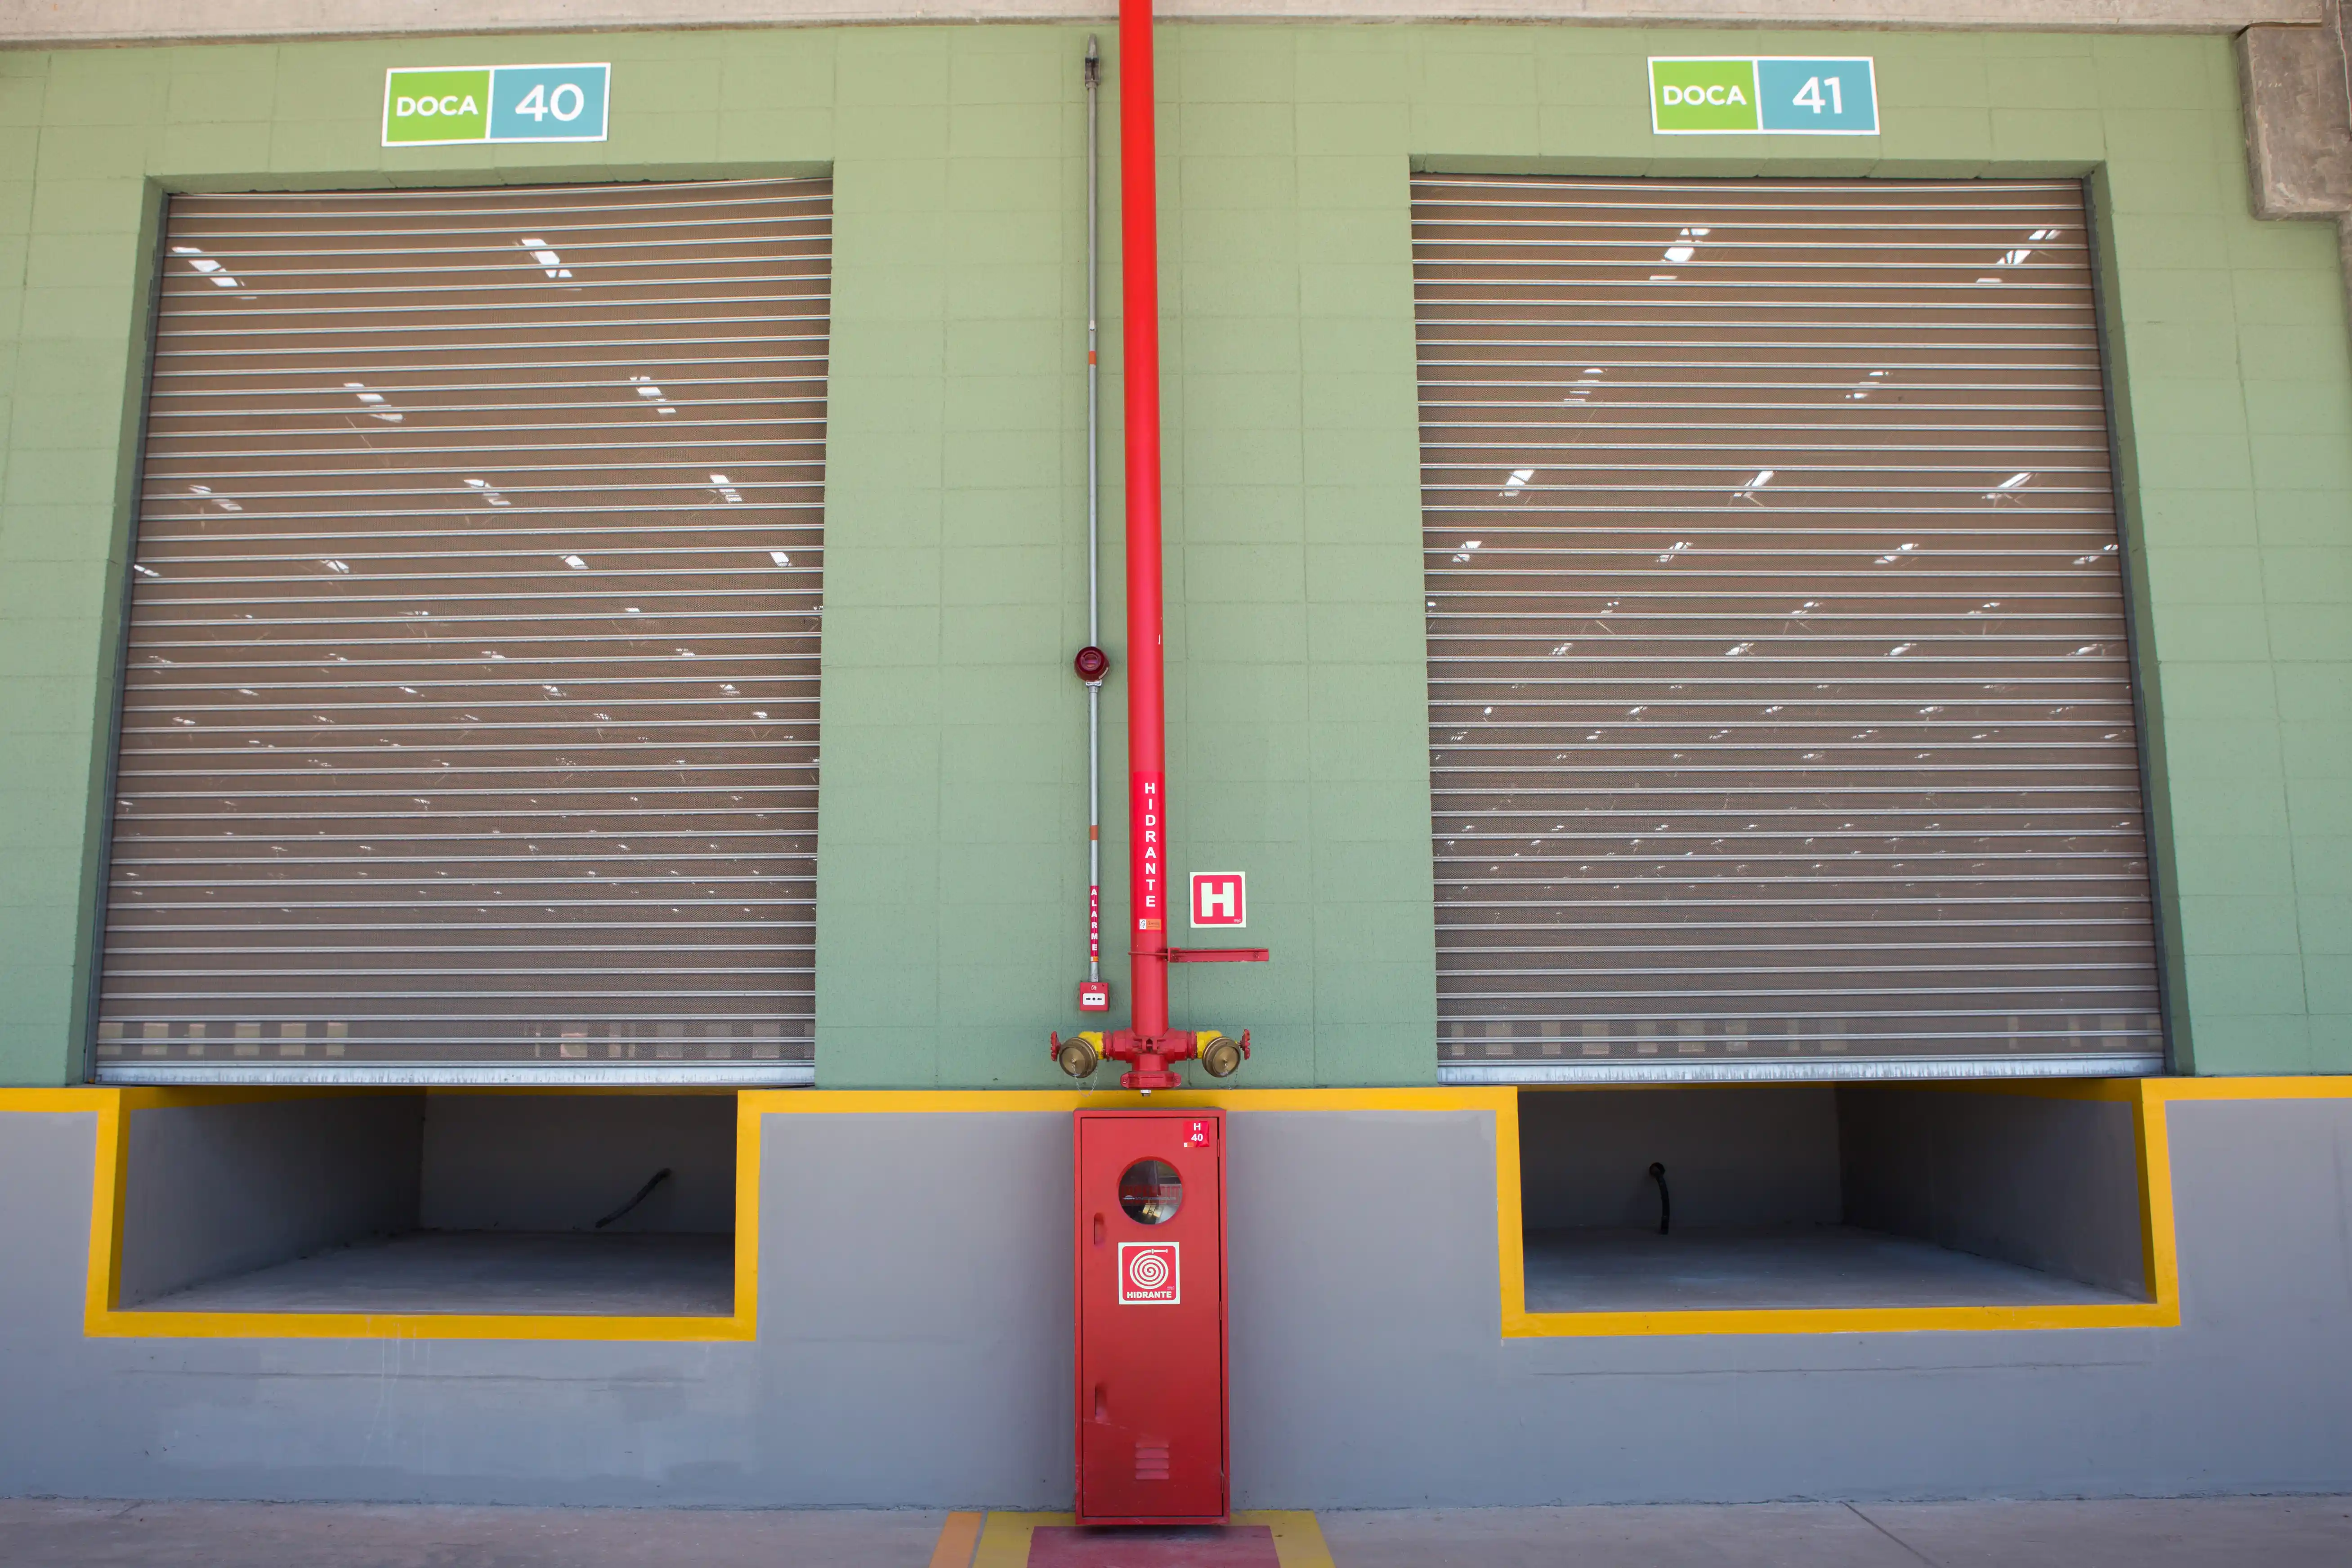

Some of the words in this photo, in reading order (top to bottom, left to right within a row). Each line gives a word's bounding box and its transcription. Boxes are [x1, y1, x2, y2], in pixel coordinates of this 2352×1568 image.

[396, 95, 479, 117] DOCA
[514, 83, 584, 122] 40
[1662, 85, 1747, 106] DOCA
[1792, 76, 1842, 114] 41
[1145, 782, 1157, 907] HIDRANTE
[1201, 882, 1235, 917] H
[1191, 1133, 1203, 1142] 40
[1194, 1122, 1201, 1131] H
